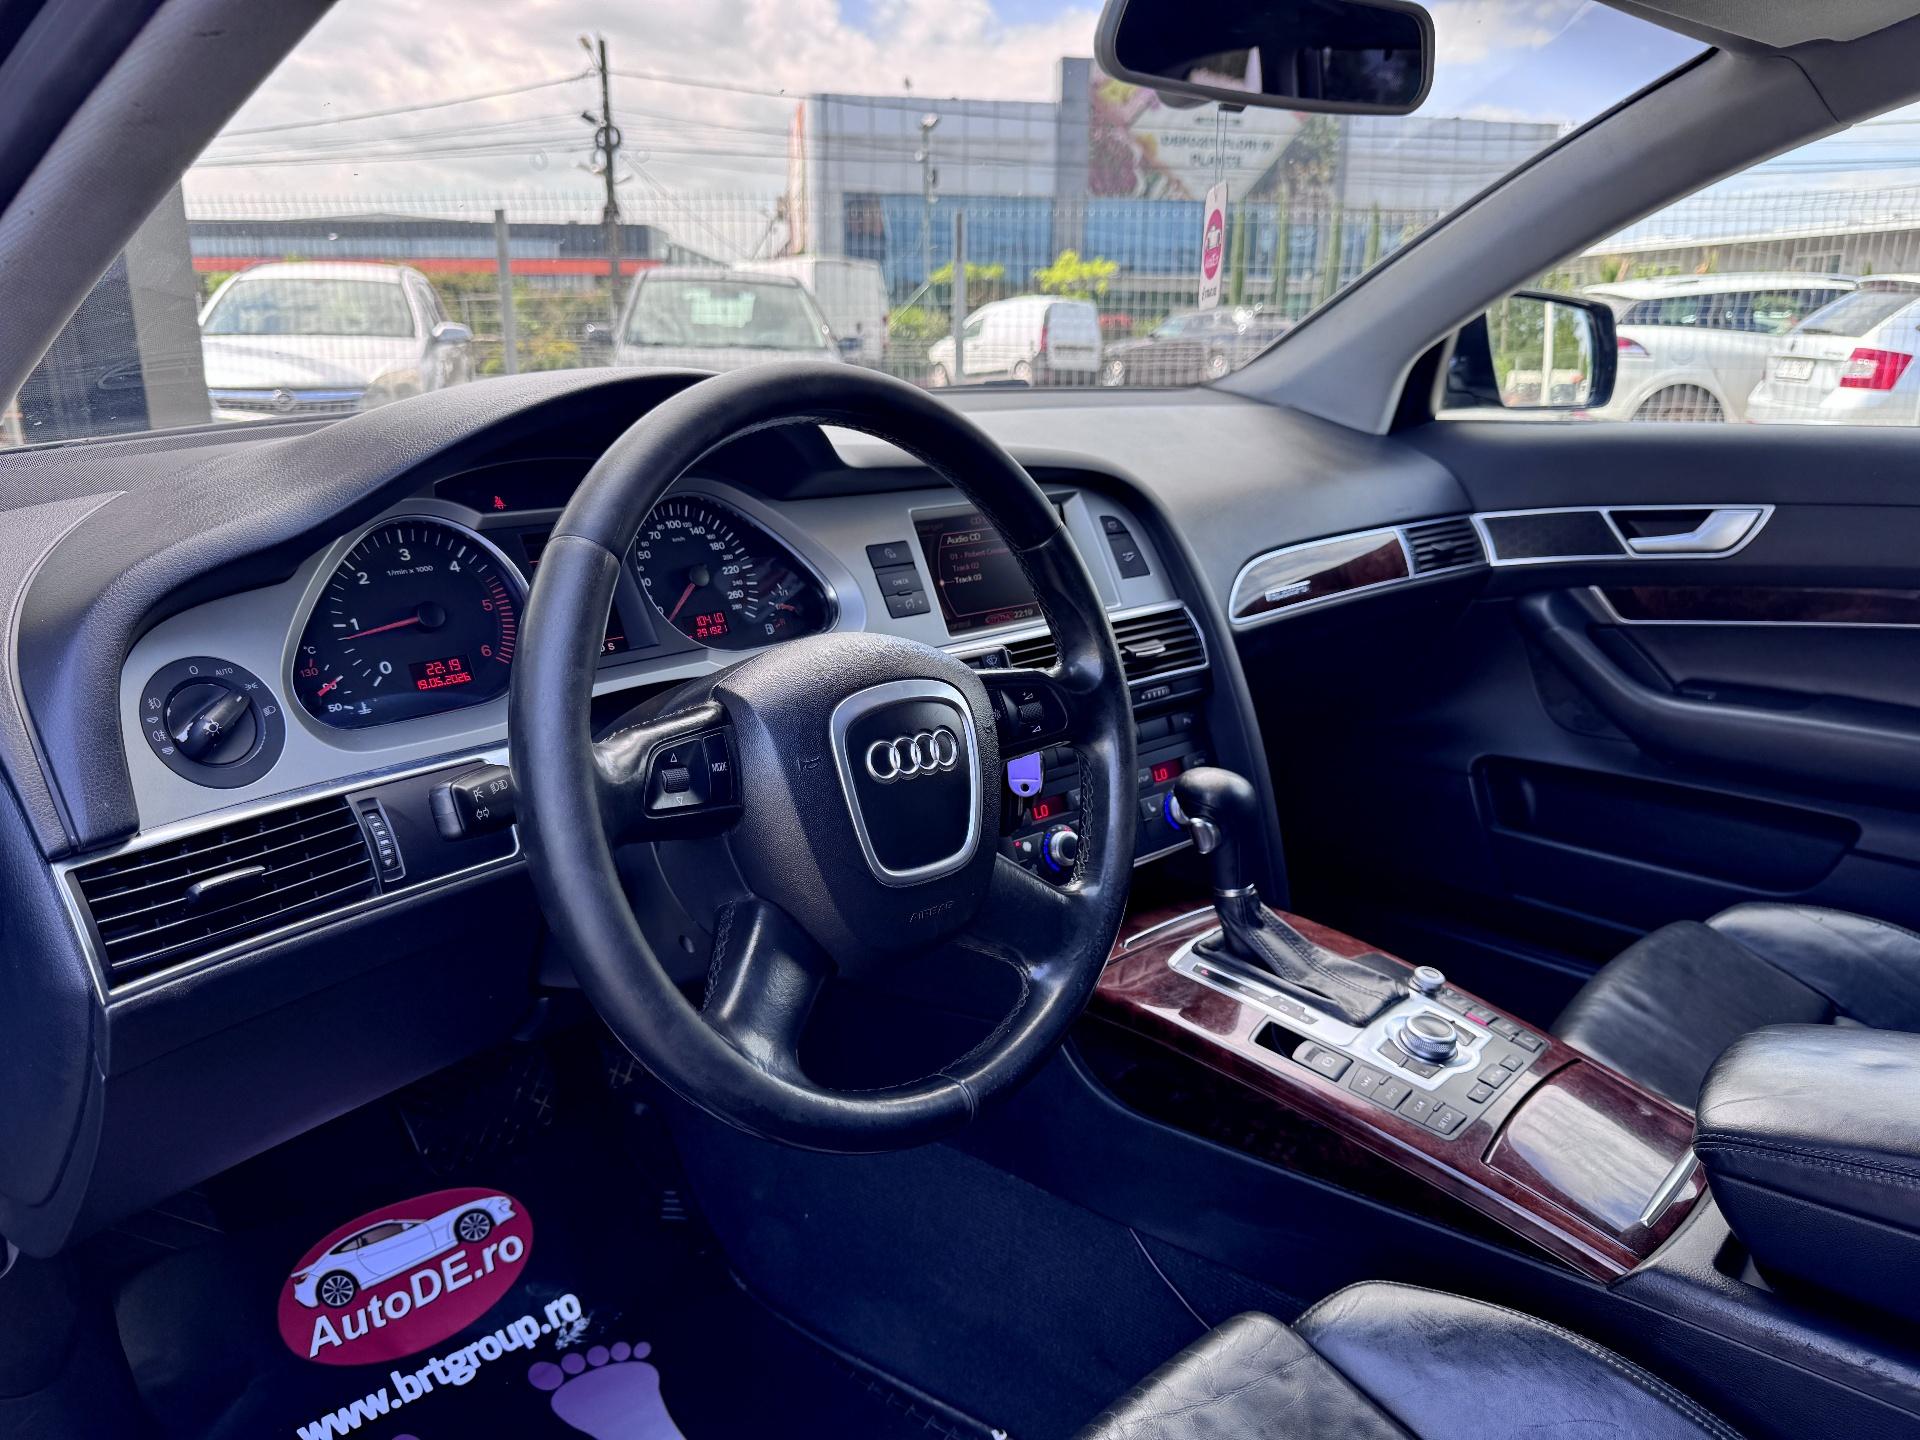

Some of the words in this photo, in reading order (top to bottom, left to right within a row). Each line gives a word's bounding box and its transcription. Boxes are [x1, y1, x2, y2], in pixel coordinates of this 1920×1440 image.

[666, 520, 682, 530] 100
[649, 530, 661, 540] 70
[689, 526, 705, 536] 140
[946, 535, 968, 544] Audio
[969, 532, 981, 541] CD
[709, 541, 725, 551] 180
[399, 548, 411, 561] 3
[638, 551, 651, 560] 50
[415, 565, 434, 573] 1000
[450, 561, 461, 573] 4
[722, 565, 740, 575] 220
[357, 572, 370, 585] 2
[955, 575, 972, 584] Track
[727, 589, 744, 600] 260
[482, 599, 493, 612] 5
[350, 618, 360, 630] 1
[481, 644, 492, 657] 6
[607, 642, 616, 651] S
[215, 667, 234, 676] AUTO
[300, 667, 319, 678] 130
[379, 661, 392, 675] 0
[425, 659, 462, 676] 22:19
[417, 672, 472, 690] 19.05.2026
[327, 702, 343, 713] 50
[308, 1234, 525, 1359] AutoDE.ro
[296, 1293, 582, 1440] www.brtgroup.ro
